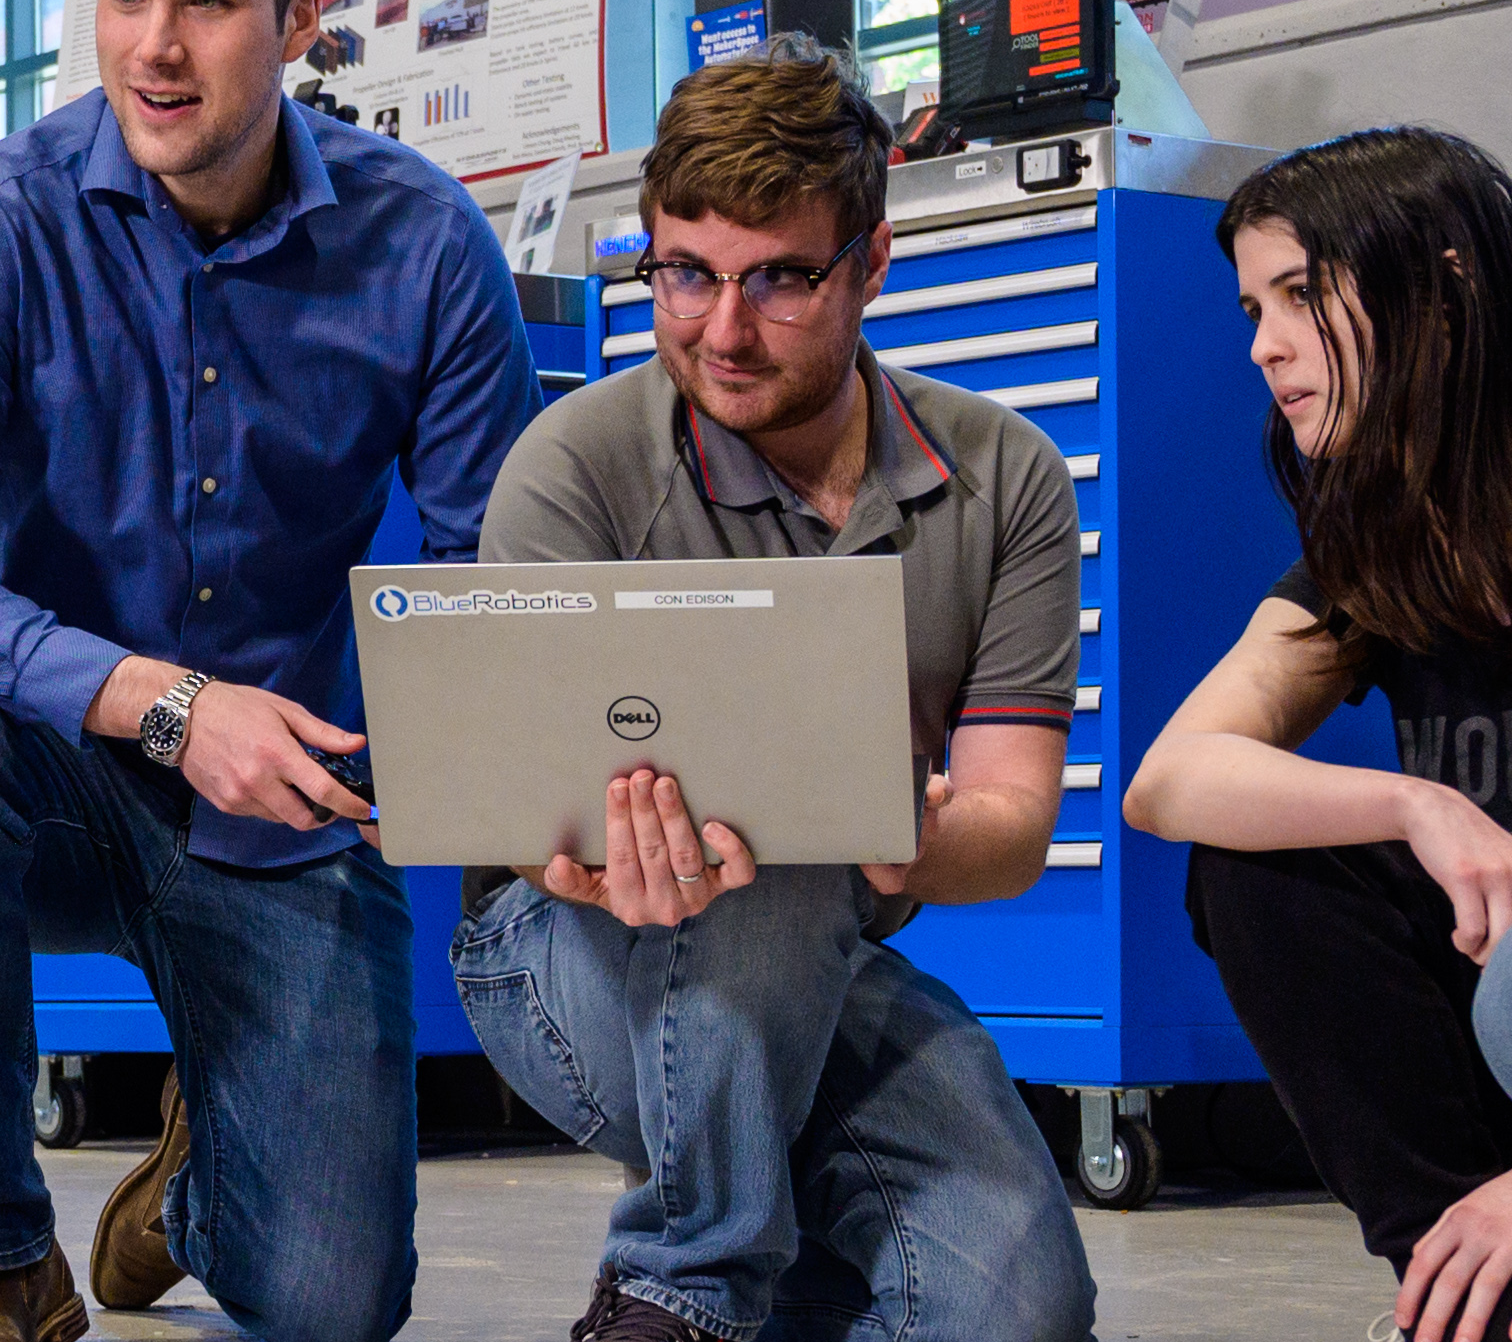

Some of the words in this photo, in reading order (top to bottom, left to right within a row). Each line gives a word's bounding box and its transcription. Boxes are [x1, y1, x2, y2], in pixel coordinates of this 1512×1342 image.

[1020, 31, 1038, 45] TOOL
[521, 76, 540, 89] Other
[540, 69, 566, 87] Testing
[412, 593, 593, 613] BlueRobotics
[654, 594, 684, 606] CON
[686, 594, 735, 606] EDISON
[612, 712, 656, 725] DELL
